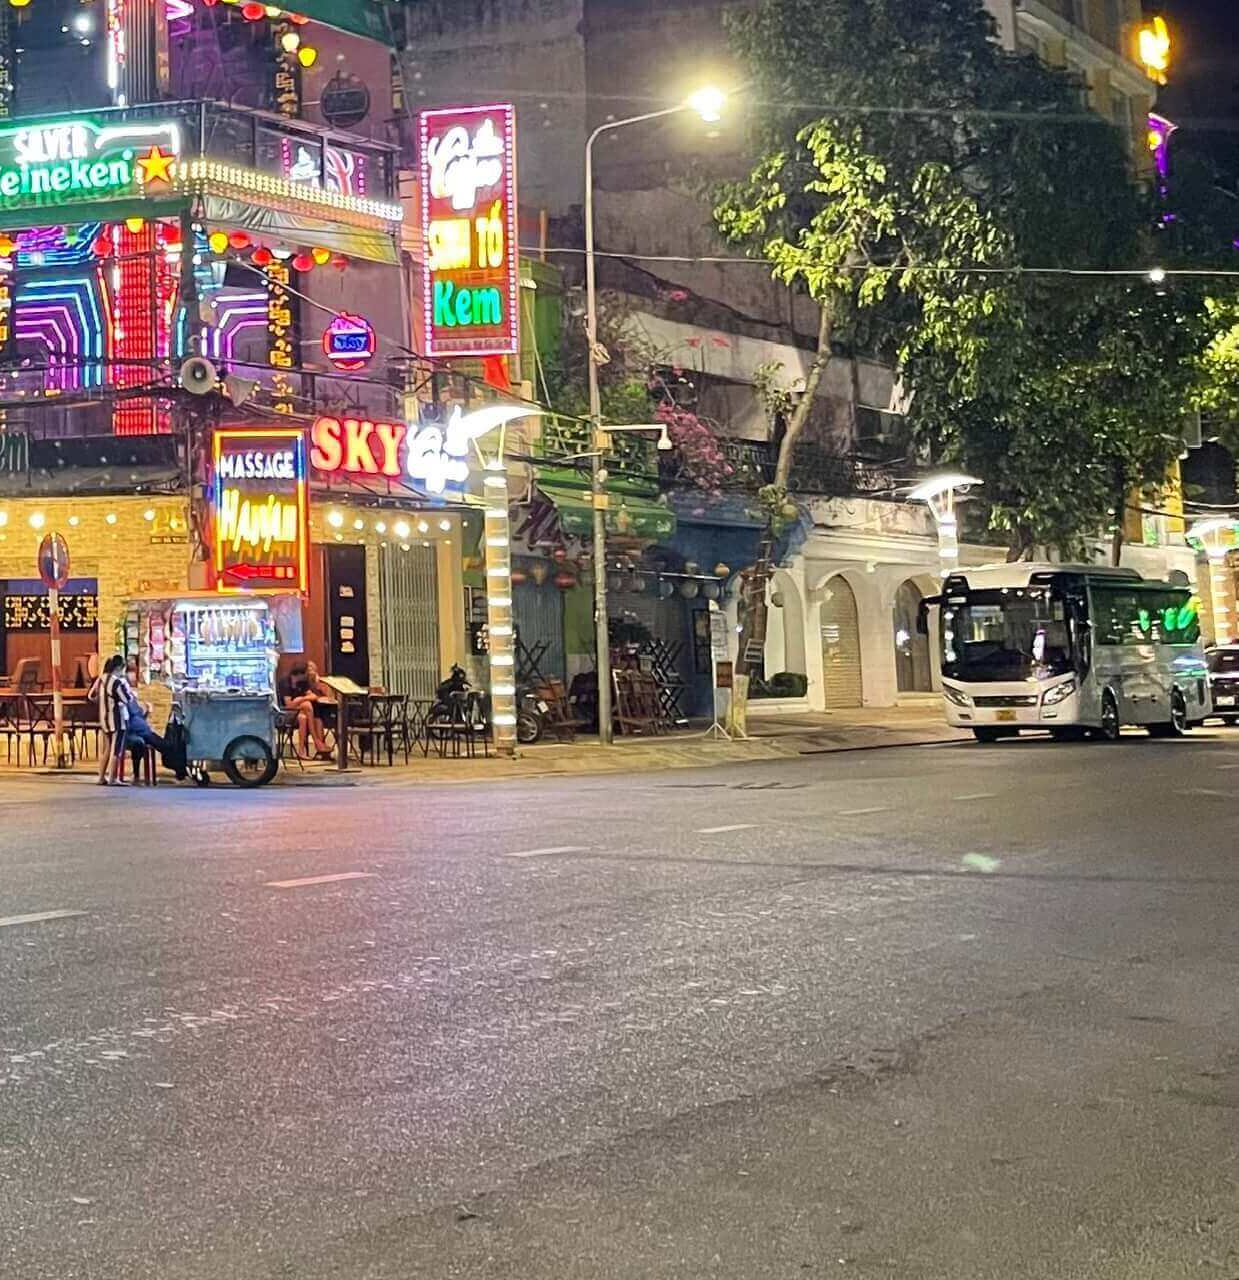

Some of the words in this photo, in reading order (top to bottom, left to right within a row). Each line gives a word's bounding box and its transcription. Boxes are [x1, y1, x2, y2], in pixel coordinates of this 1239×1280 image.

[13, 126, 88, 164] SILVER
[433, 280, 502, 327] Kem
[221, 452, 294, 478] MASSAGE
[311, 416, 406, 476] SKY
